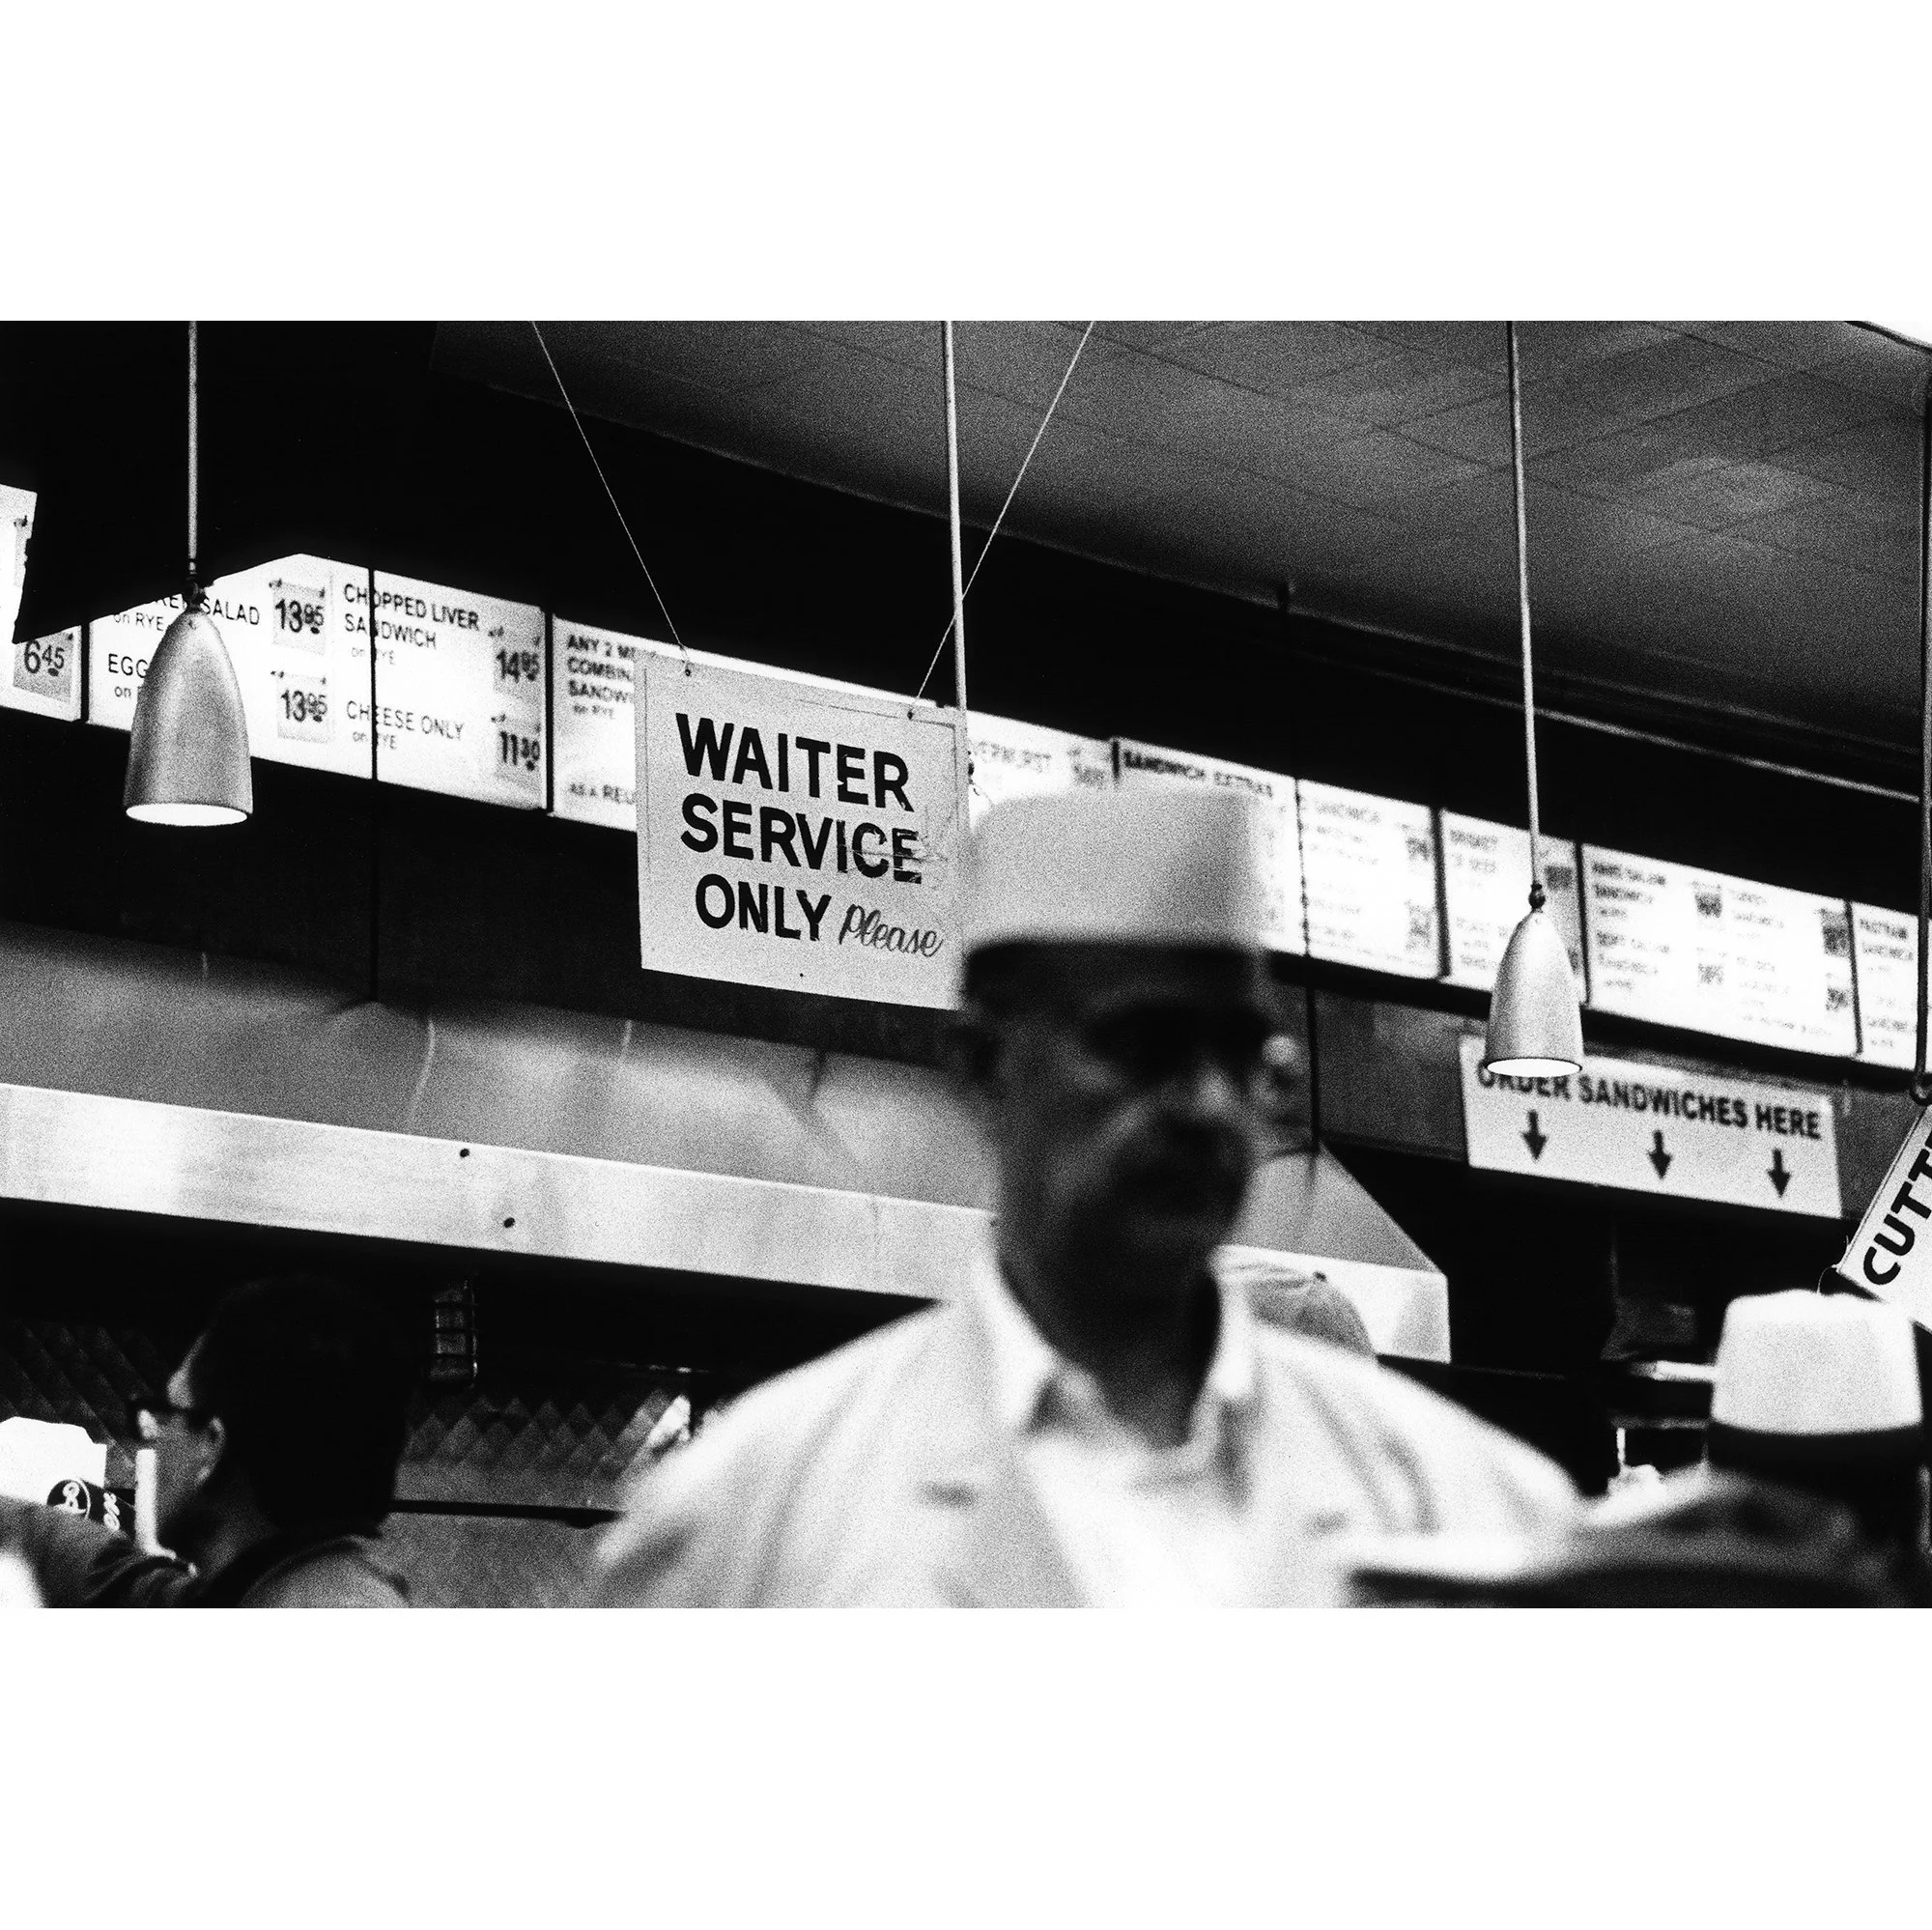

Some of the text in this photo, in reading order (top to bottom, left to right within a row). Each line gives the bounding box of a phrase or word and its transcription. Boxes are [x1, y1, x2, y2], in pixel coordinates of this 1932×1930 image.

[199, 598, 261, 626] SALAD
[344, 583, 480, 631] CHOPPED LIVER
[135, 612, 164, 632] RYE
[344, 612, 437, 650] SADWICH
[567, 634, 599, 652] ANY
[604, 640, 612, 658] 2
[108, 653, 149, 679] EGG
[567, 656, 635, 682] COMBIN
[114, 686, 132, 699] on
[567, 679, 635, 703] SANDW
[421, 715, 465, 742] ONLY
[675, 712, 915, 812] WAITER
[680, 792, 922, 885] SERVICE
[696, 873, 945, 958] ONLY Please
[1577, 1074, 1748, 1129] SANDWICHES
[1755, 1104, 1823, 1141] HERE
[1863, 1127, 1932, 1287] CUTT
